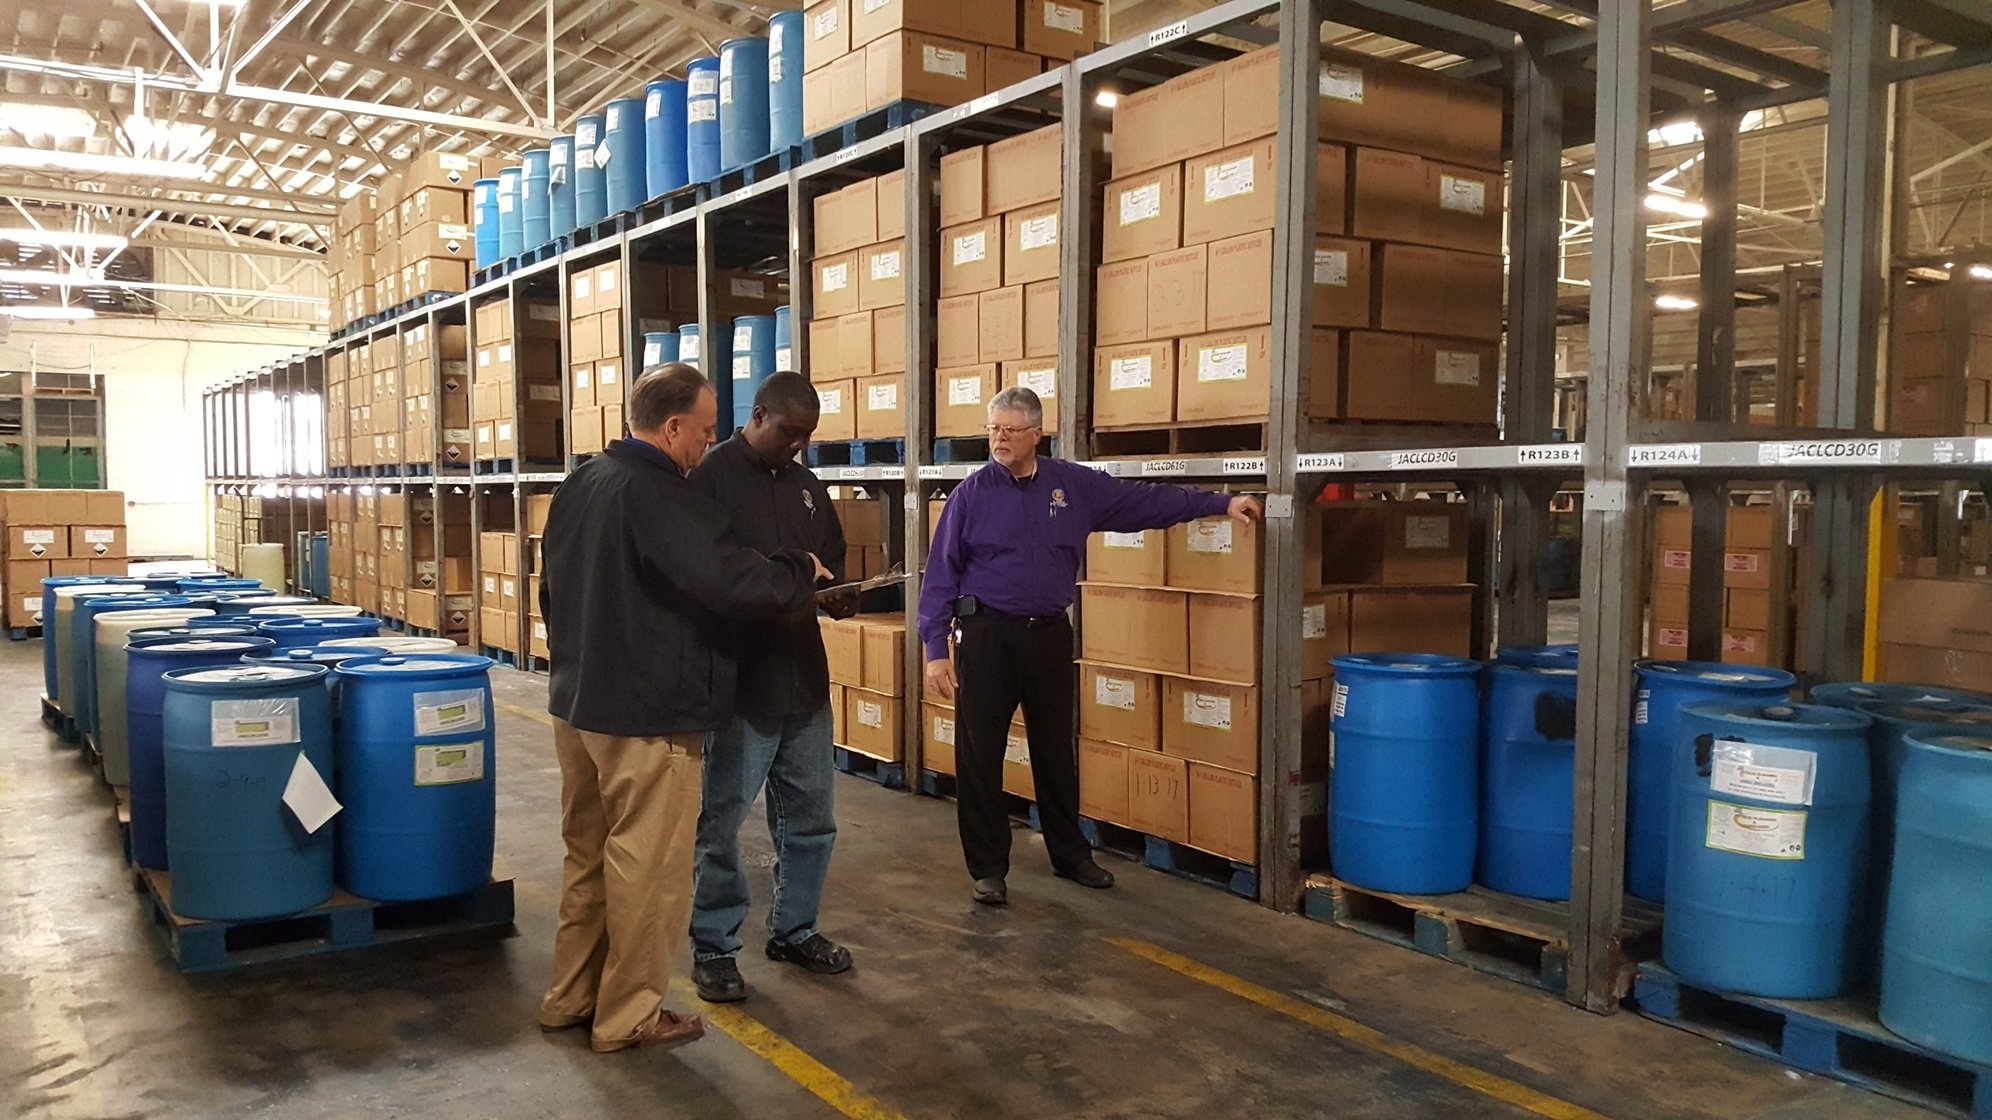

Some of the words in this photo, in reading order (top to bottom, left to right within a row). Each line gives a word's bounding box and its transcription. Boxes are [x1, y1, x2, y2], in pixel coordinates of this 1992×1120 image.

[1155, 26, 1181, 42] R122C
[1528, 449, 1570, 460] R123B
[1640, 449, 1688, 461] R124A
[1229, 462, 1258, 470] R122B
[1304, 458, 1336, 467] R123A
